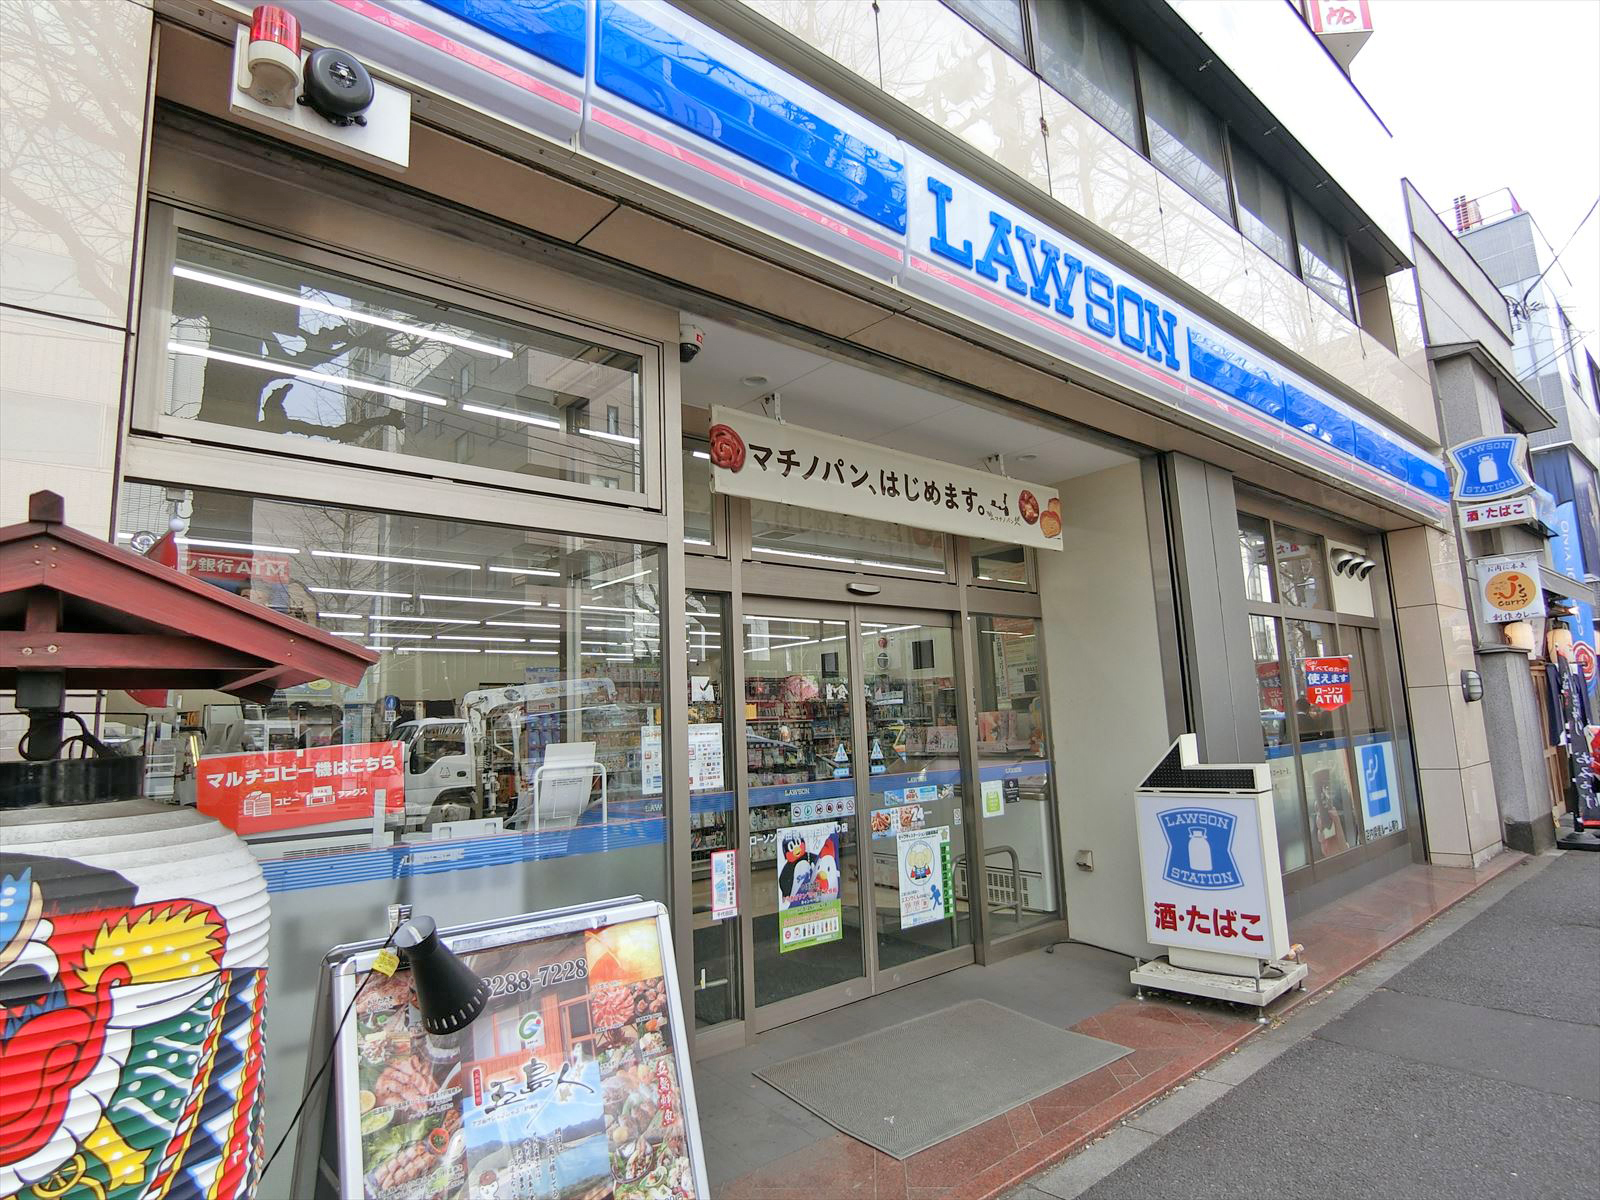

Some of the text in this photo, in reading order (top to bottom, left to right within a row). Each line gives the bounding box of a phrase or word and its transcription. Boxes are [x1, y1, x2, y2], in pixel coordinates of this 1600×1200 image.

[927, 176, 1180, 371] LAWSON
[1460, 442, 1510, 459] LAWSON
[748, 442, 985, 516] マチノパン、はじめます。
[1466, 478, 1515, 494] STATION
[1466, 503, 1525, 522] 酒・たばこ
[1307, 672, 1349, 685] 使えます
[1314, 687, 1343, 695] ローソン
[1315, 694, 1344, 704] ATM
[206, 755, 396, 789] マルチコピー機はこちら
[274, 797, 300, 807] コピー
[1164, 813, 1230, 830] LAWSON
[749, 833, 777, 846] ローソン
[1171, 867, 1234, 885] STATION
[1154, 901, 1264, 942] 酒・たばこ
